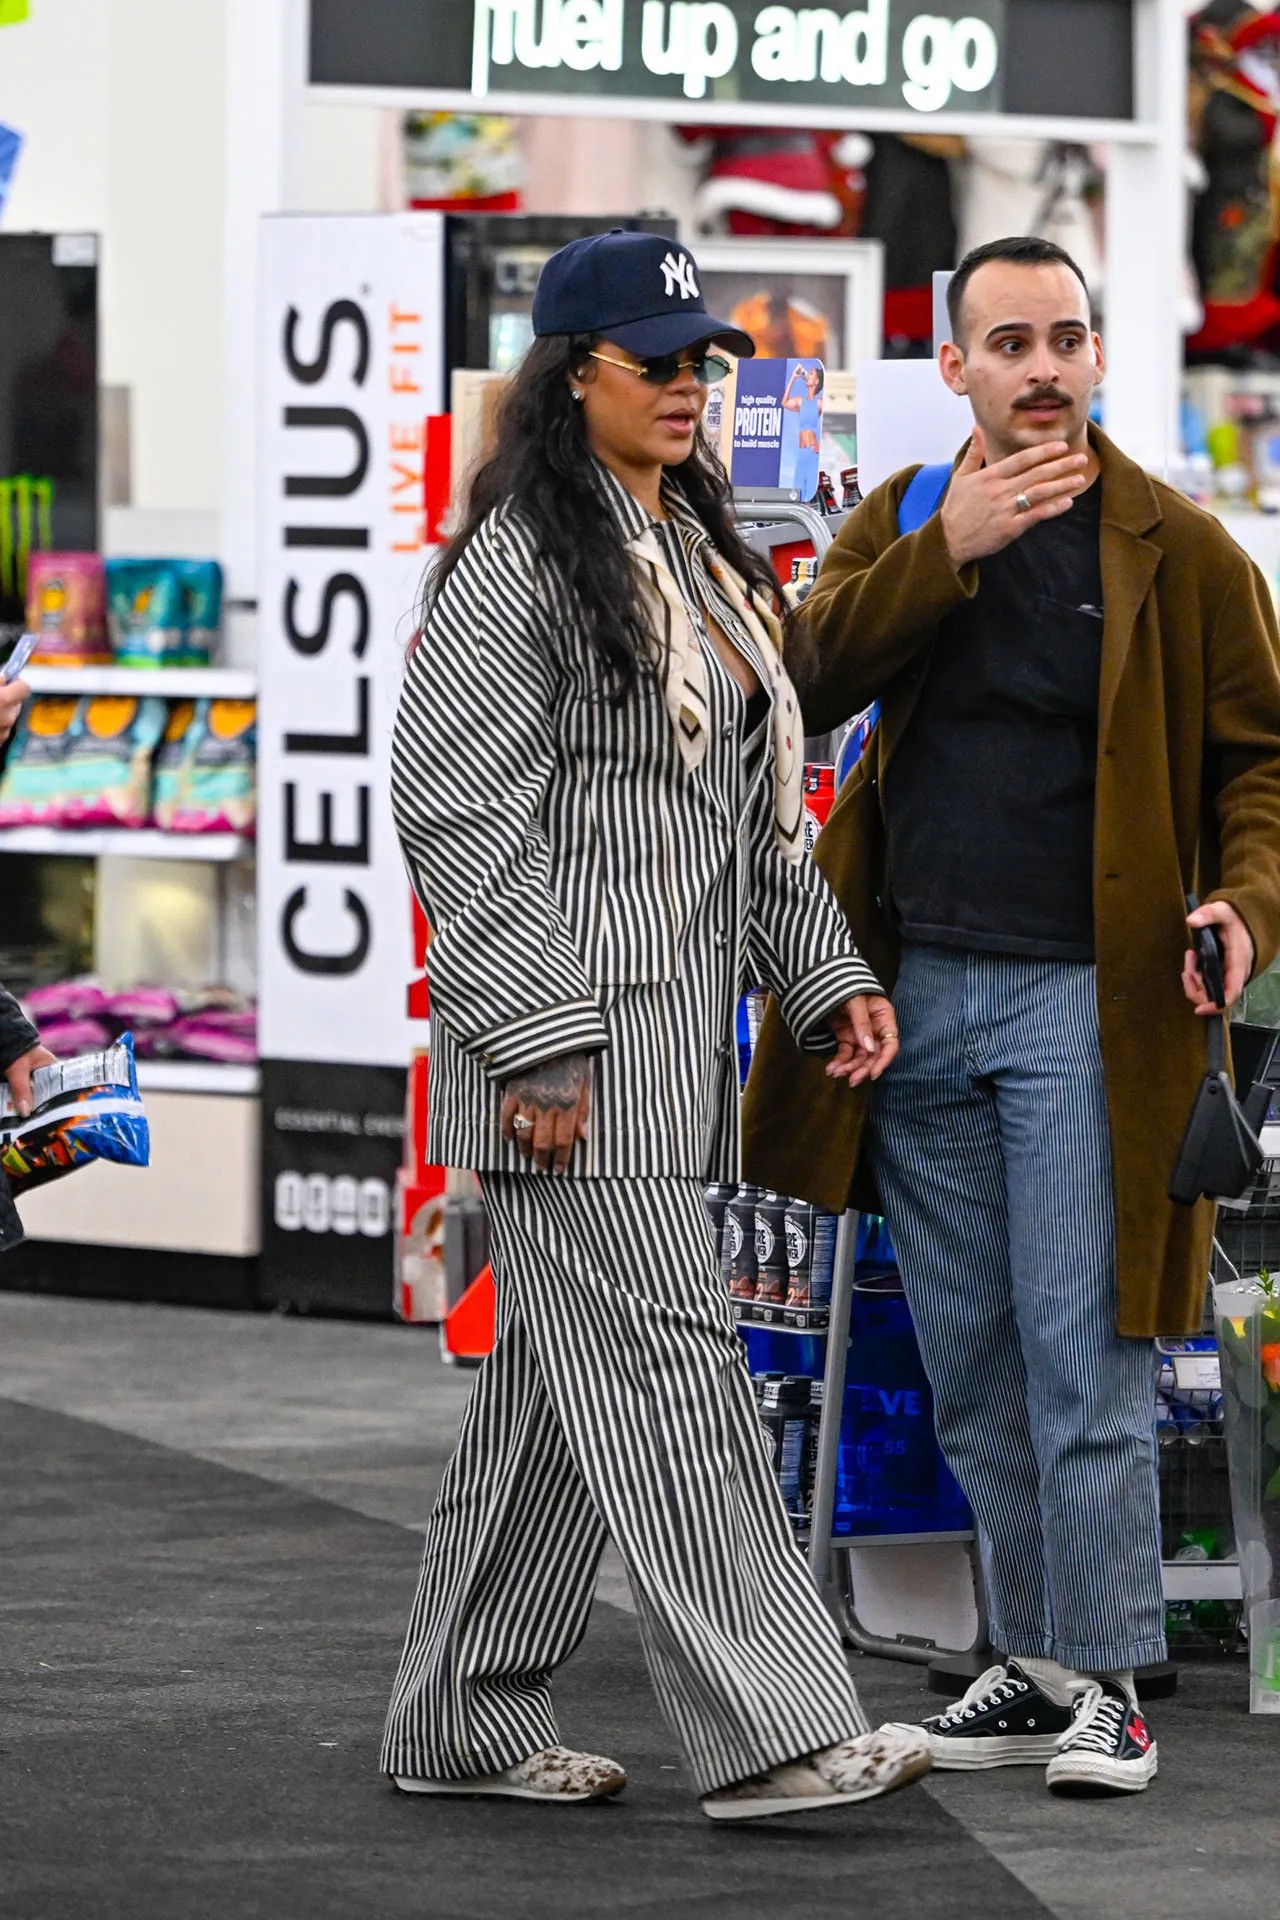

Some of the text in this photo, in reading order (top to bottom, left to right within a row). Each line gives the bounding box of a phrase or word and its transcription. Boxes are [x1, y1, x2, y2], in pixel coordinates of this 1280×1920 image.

[641, 1, 738, 98] up
[751, 0, 889, 86] and
[902, 14, 998, 112] go
[659, 251, 700, 300] NY
[734, 407, 782, 437] PROTEIN
[741, 395, 777, 406] high quality
[389, 302, 423, 554] LIVE FIT
[734, 439, 780, 449] to build muscle
[281, 298, 371, 976] CELSIUS
